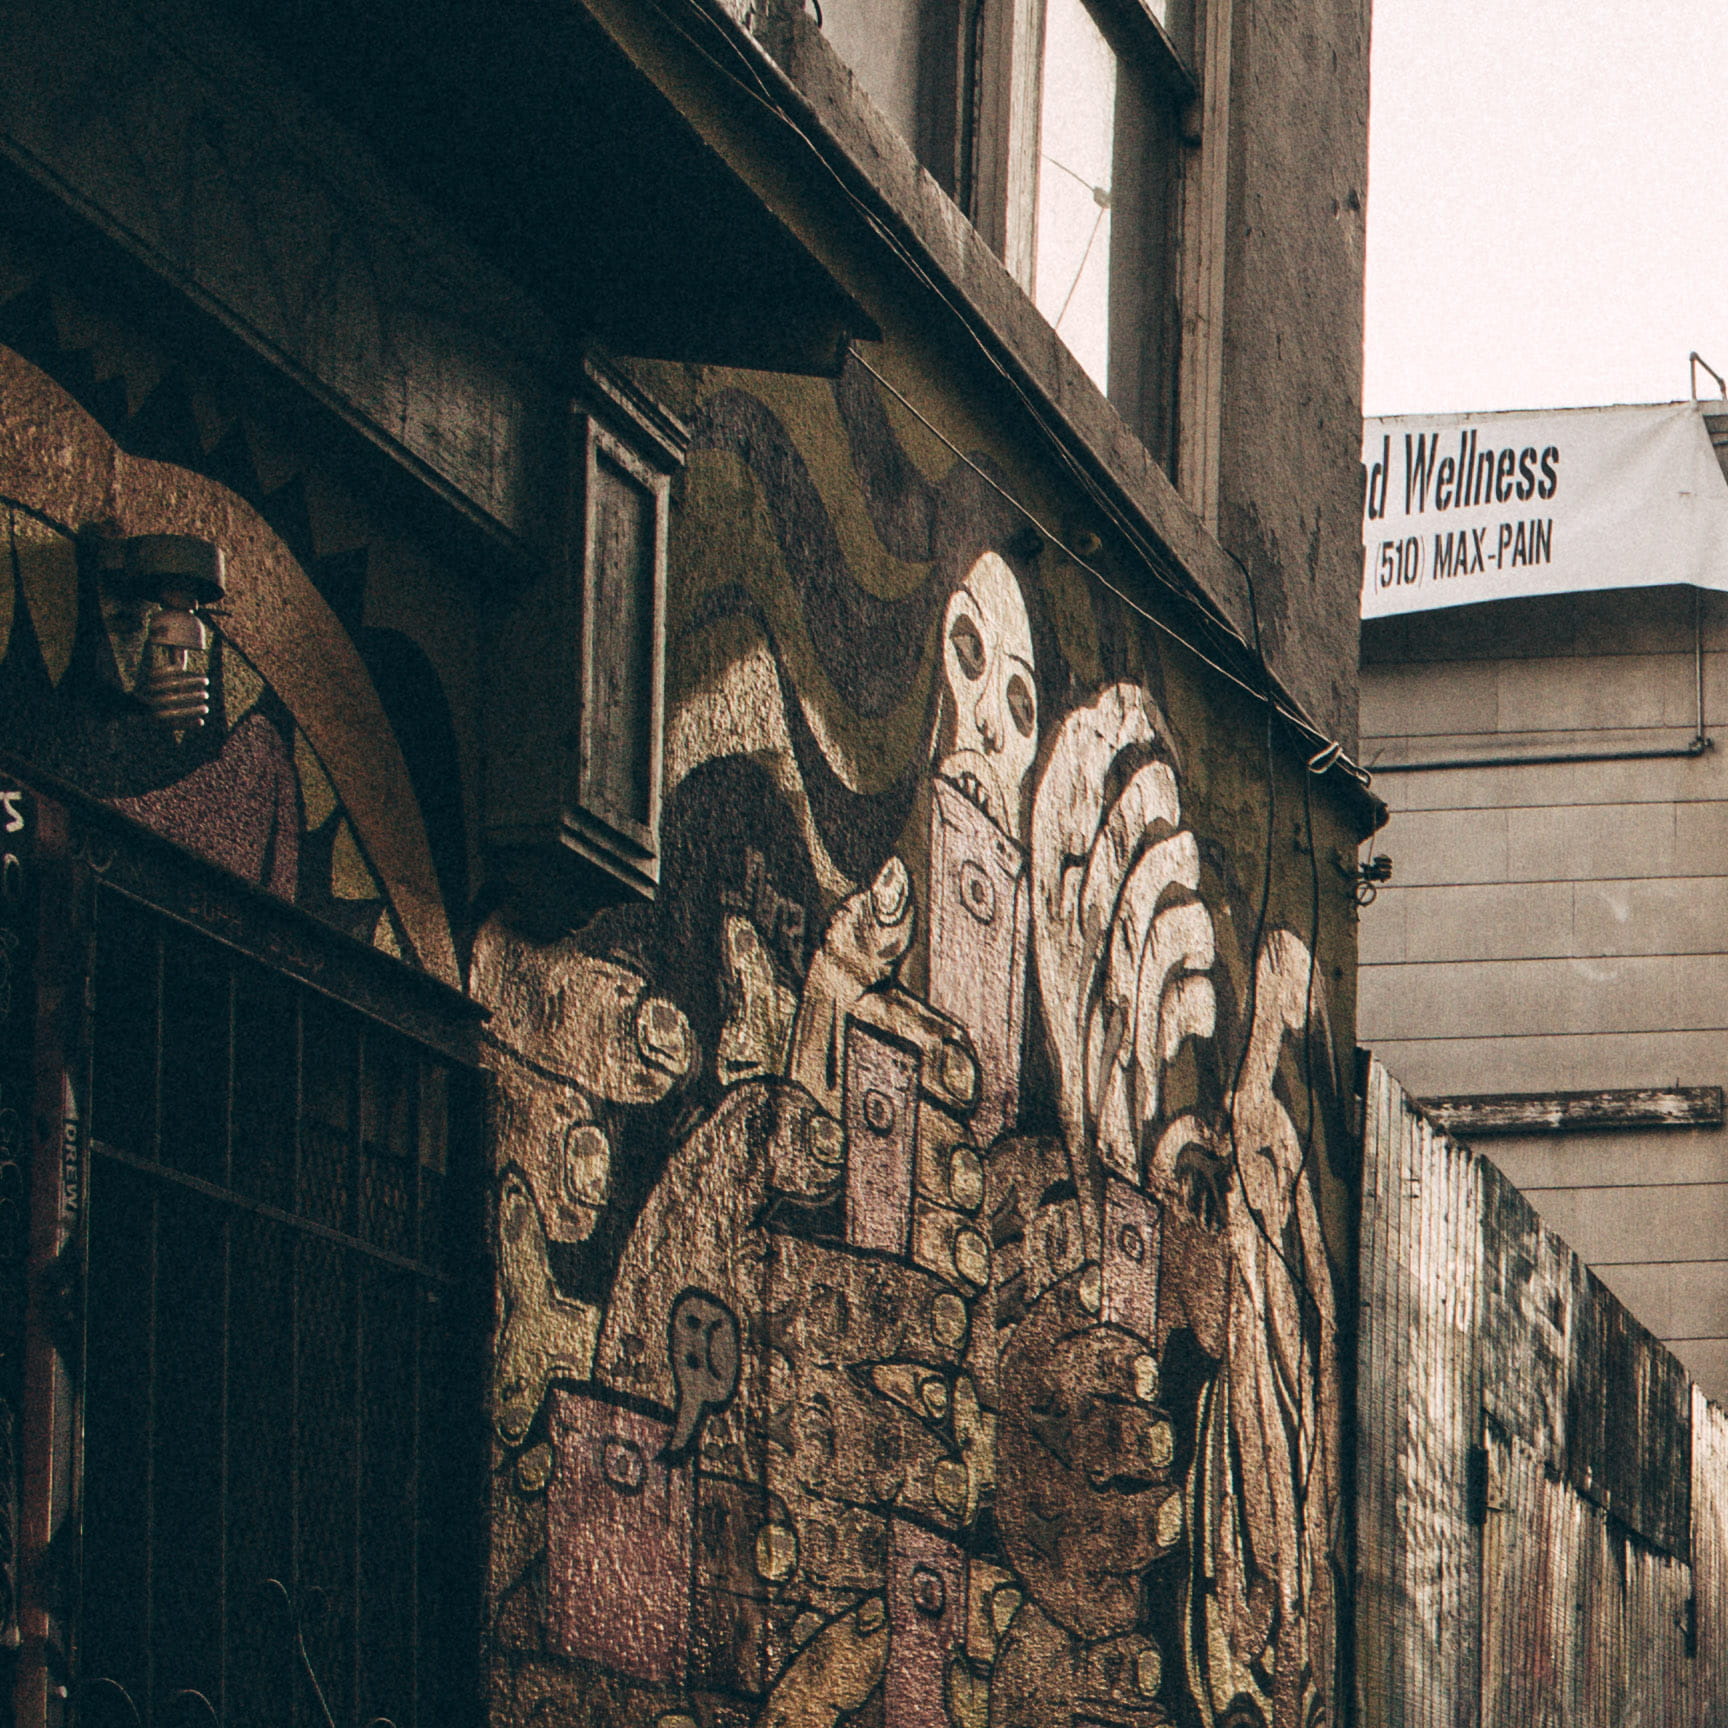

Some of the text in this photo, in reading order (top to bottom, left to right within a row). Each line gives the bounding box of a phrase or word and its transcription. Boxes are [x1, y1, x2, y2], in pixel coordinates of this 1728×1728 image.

[1404, 428, 1560, 515] Wellness
[1374, 518, 1553, 596] (510) MAX-PAIN
